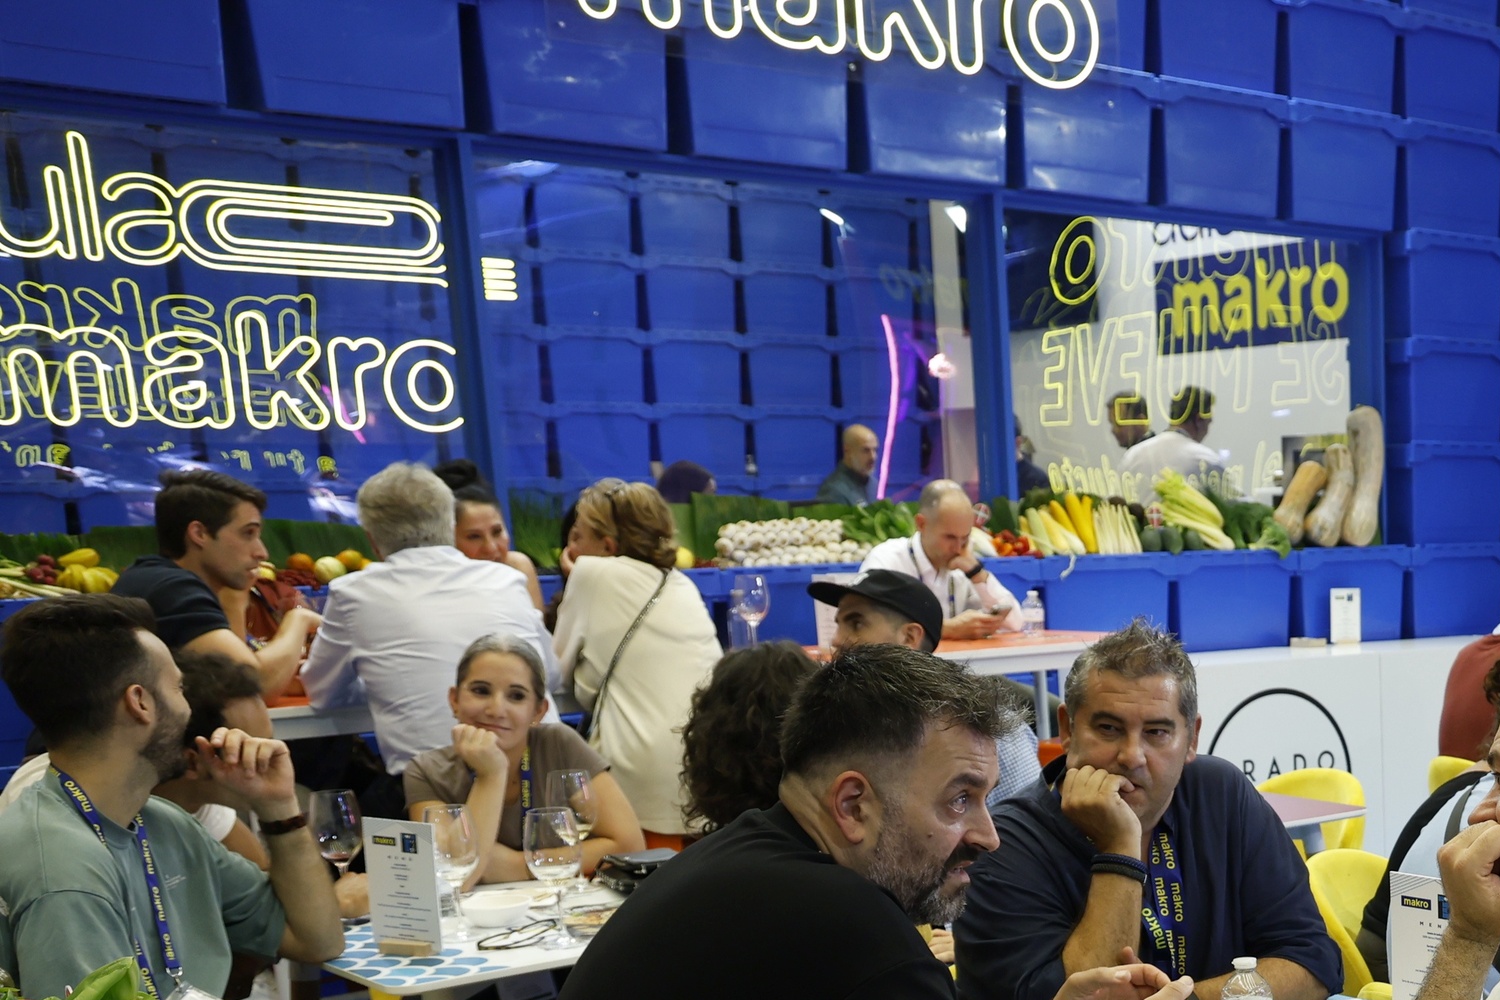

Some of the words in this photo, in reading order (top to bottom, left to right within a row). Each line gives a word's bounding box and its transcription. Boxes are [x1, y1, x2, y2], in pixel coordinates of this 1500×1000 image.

[1171, 257, 1350, 339] makro
[0, 310, 466, 433] makro
[1242, 750, 1335, 782] RADO
[64, 780, 93, 813] makro
[141, 838, 155, 875] makro
[1159, 832, 1176, 870] makro
[151, 886, 167, 923] makro
[1154, 876, 1170, 917] makro
[1170, 881, 1185, 923] makro
[1403, 896, 1429, 909] makro
[162, 932, 176, 961] akro
[1141, 907, 1168, 950] makro
[1164, 929, 1177, 969] makro
[1177, 935, 1188, 976] makro
